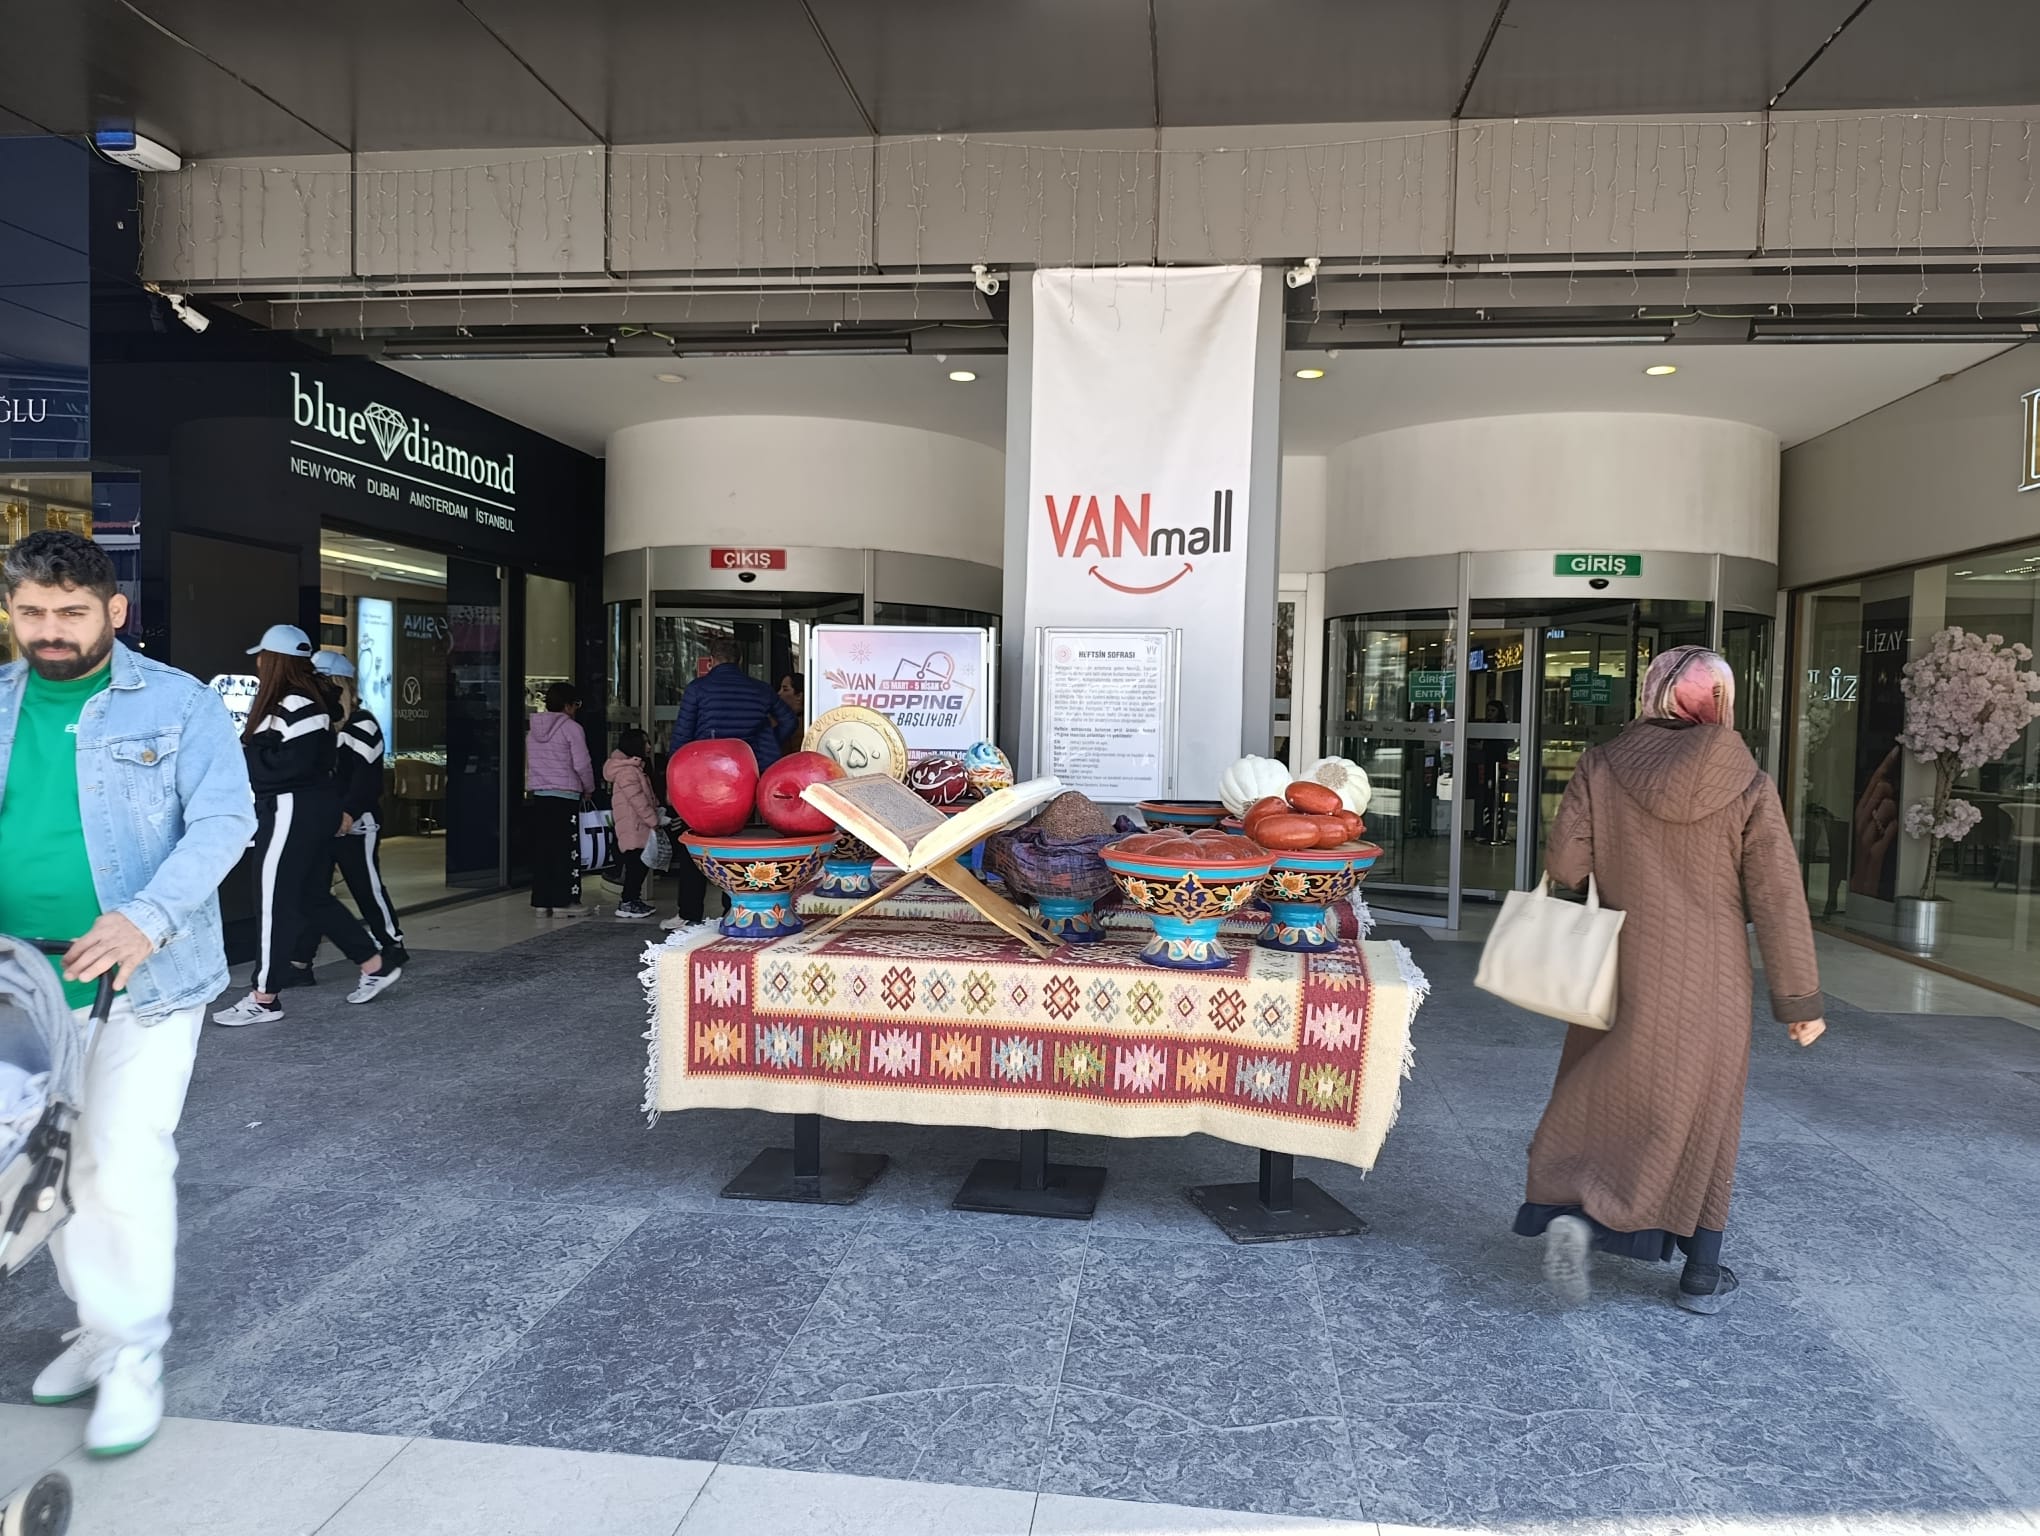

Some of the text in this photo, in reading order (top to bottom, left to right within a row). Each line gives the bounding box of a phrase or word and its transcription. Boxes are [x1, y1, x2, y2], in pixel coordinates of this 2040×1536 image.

[290, 371, 516, 495] blue diamond
[290, 456, 515, 533] NEW YORK DUBAI AMSTERDAM İSTANBUL
[1045, 489, 1233, 558] VANmall
[723, 552, 771, 569] ÇIKIŞ
[1570, 555, 1627, 576] GİRİŞ
[1107, 651, 1136, 659] SOFRASI
[846, 673, 876, 690] VAN
[841, 693, 964, 710] SHOPPING
[896, 712, 958, 728] BAŞLIYOR!
